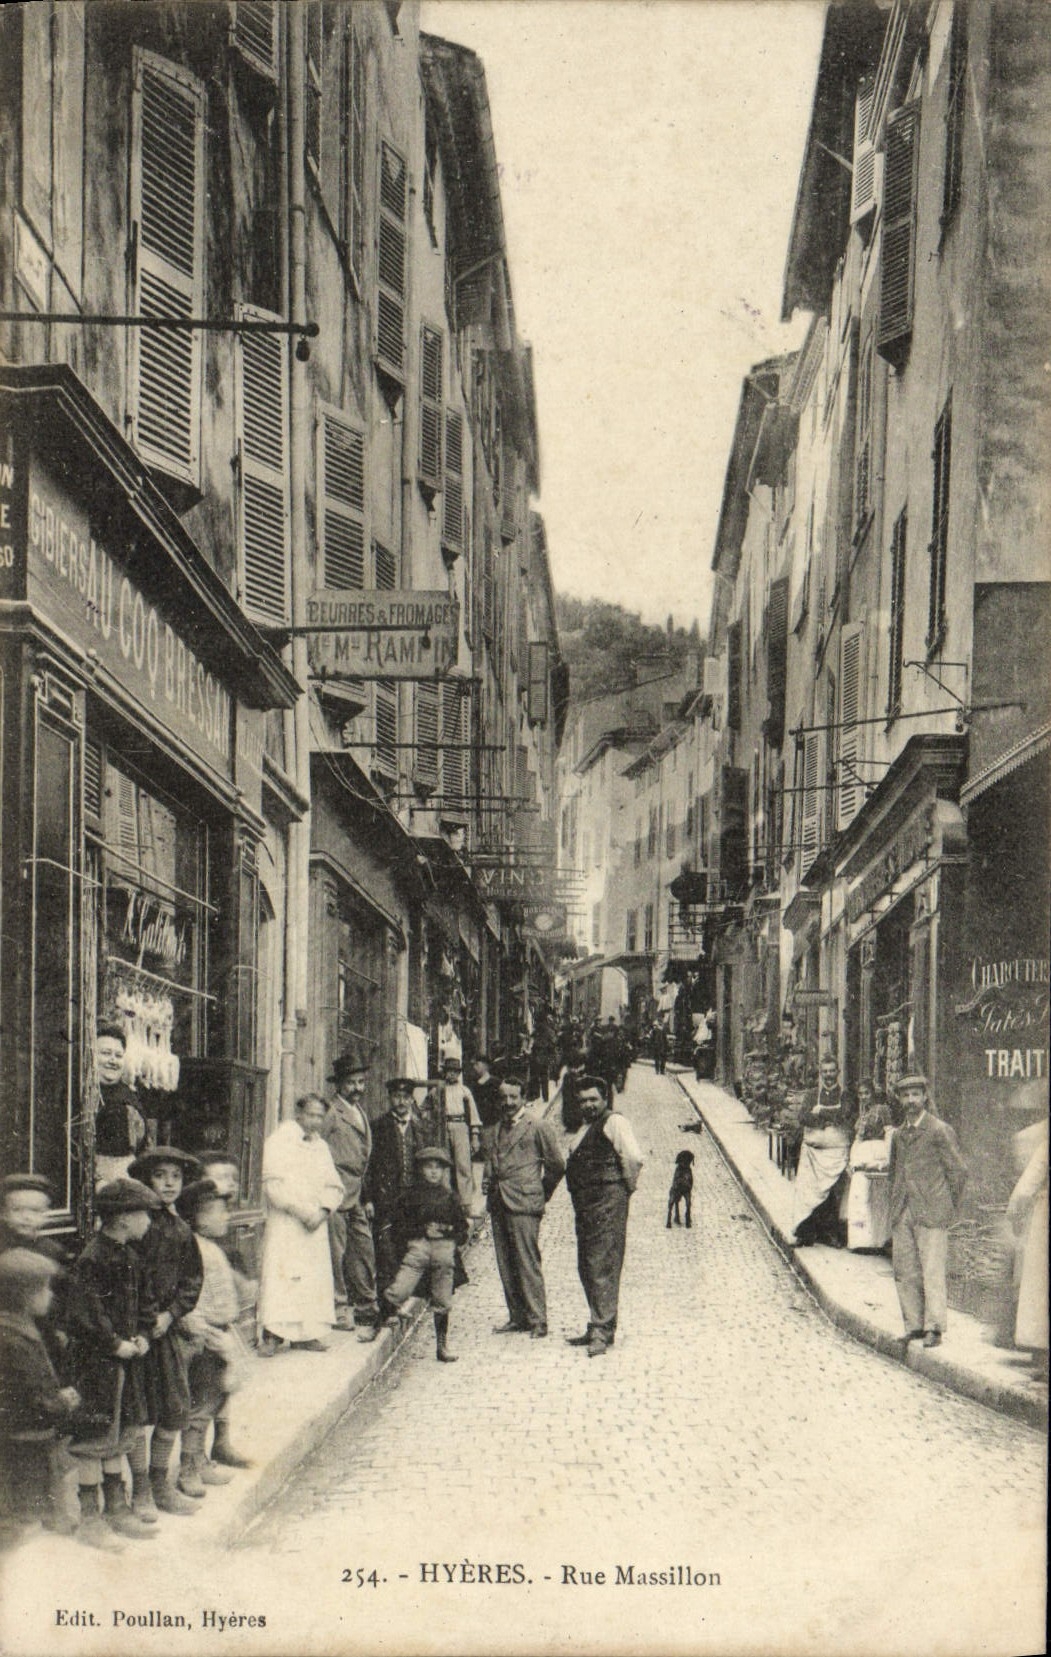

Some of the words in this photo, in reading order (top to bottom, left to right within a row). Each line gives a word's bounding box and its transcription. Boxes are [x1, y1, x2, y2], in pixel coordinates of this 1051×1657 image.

[307, 601, 375, 623] BEURRES
[378, 607, 388, 624] &
[389, 603, 459, 625] FROMAGES
[120, 577, 158, 700] COQ
[985, 1049, 1049, 1077] TRAIT
